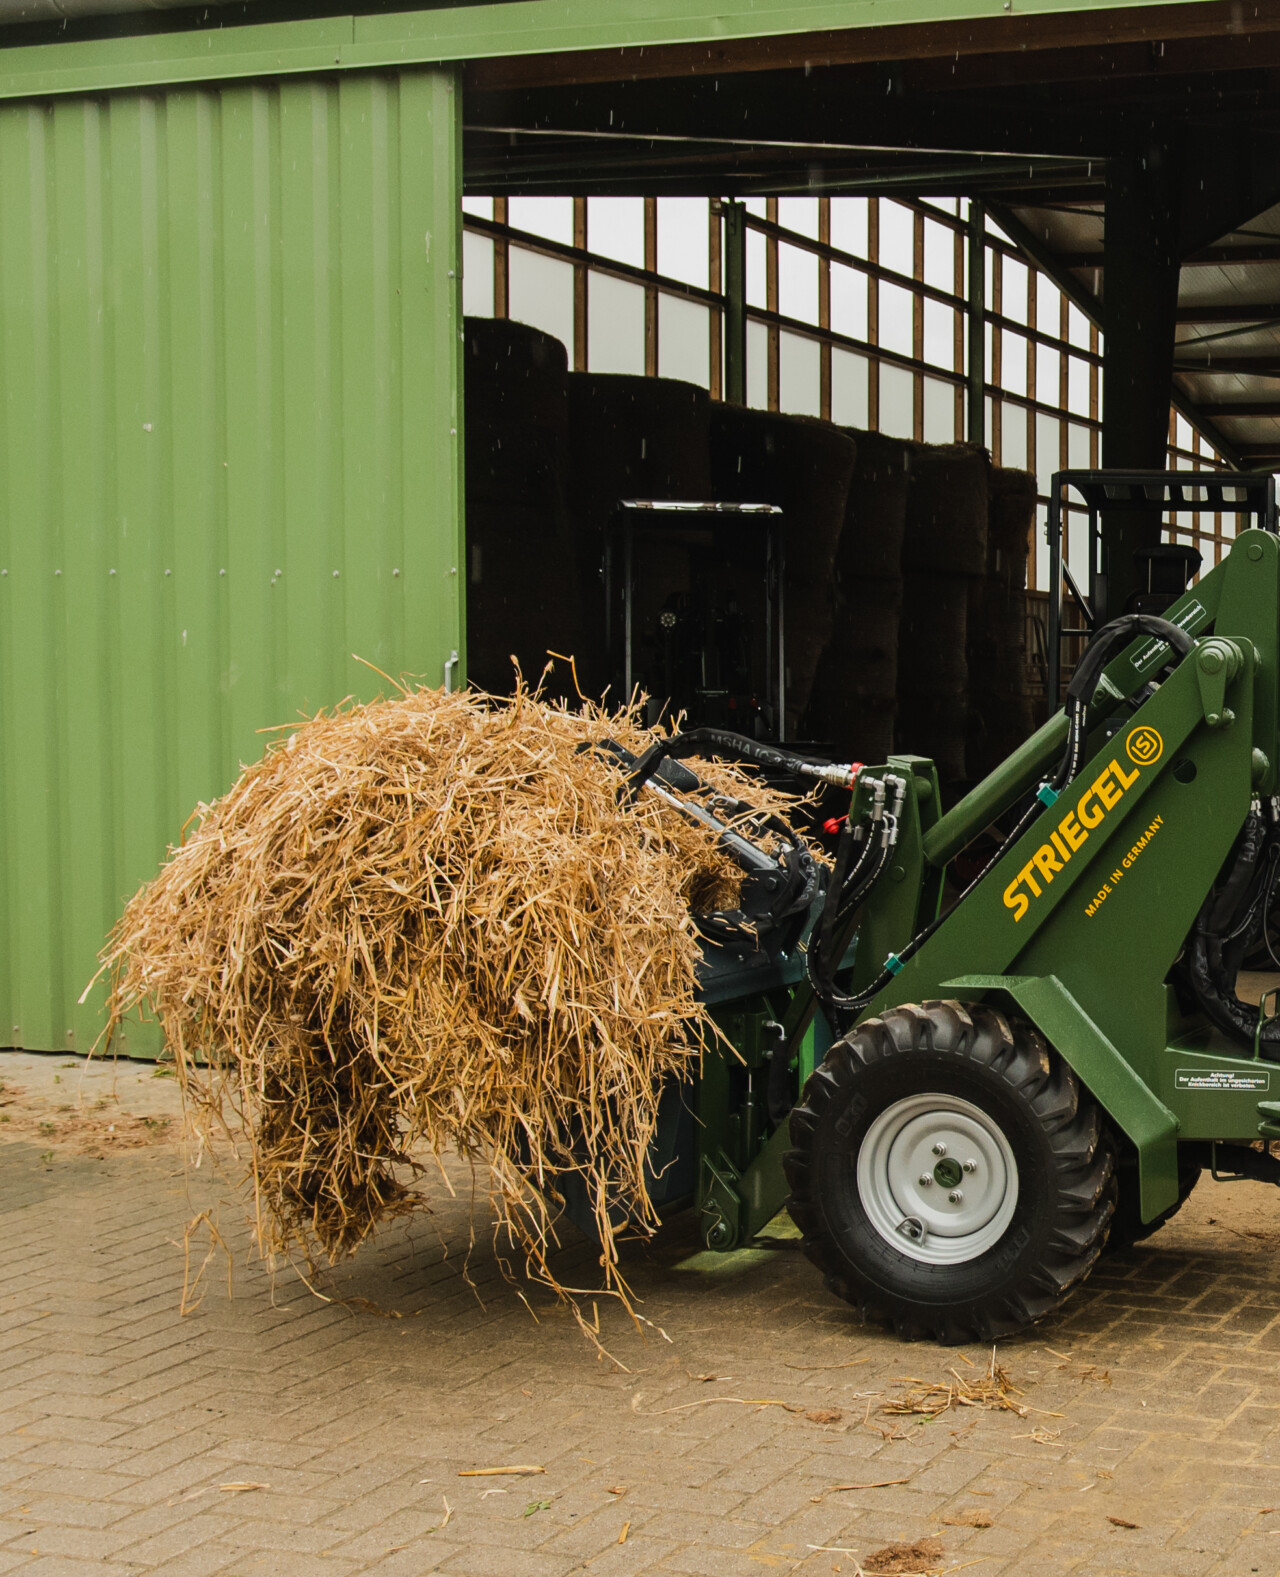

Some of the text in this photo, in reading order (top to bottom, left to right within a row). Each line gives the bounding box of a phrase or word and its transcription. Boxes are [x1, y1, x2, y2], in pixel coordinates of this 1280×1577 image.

[1003, 759, 1140, 922] STRIEGEL
[1085, 815, 1164, 917] MADE IN GERMANY
